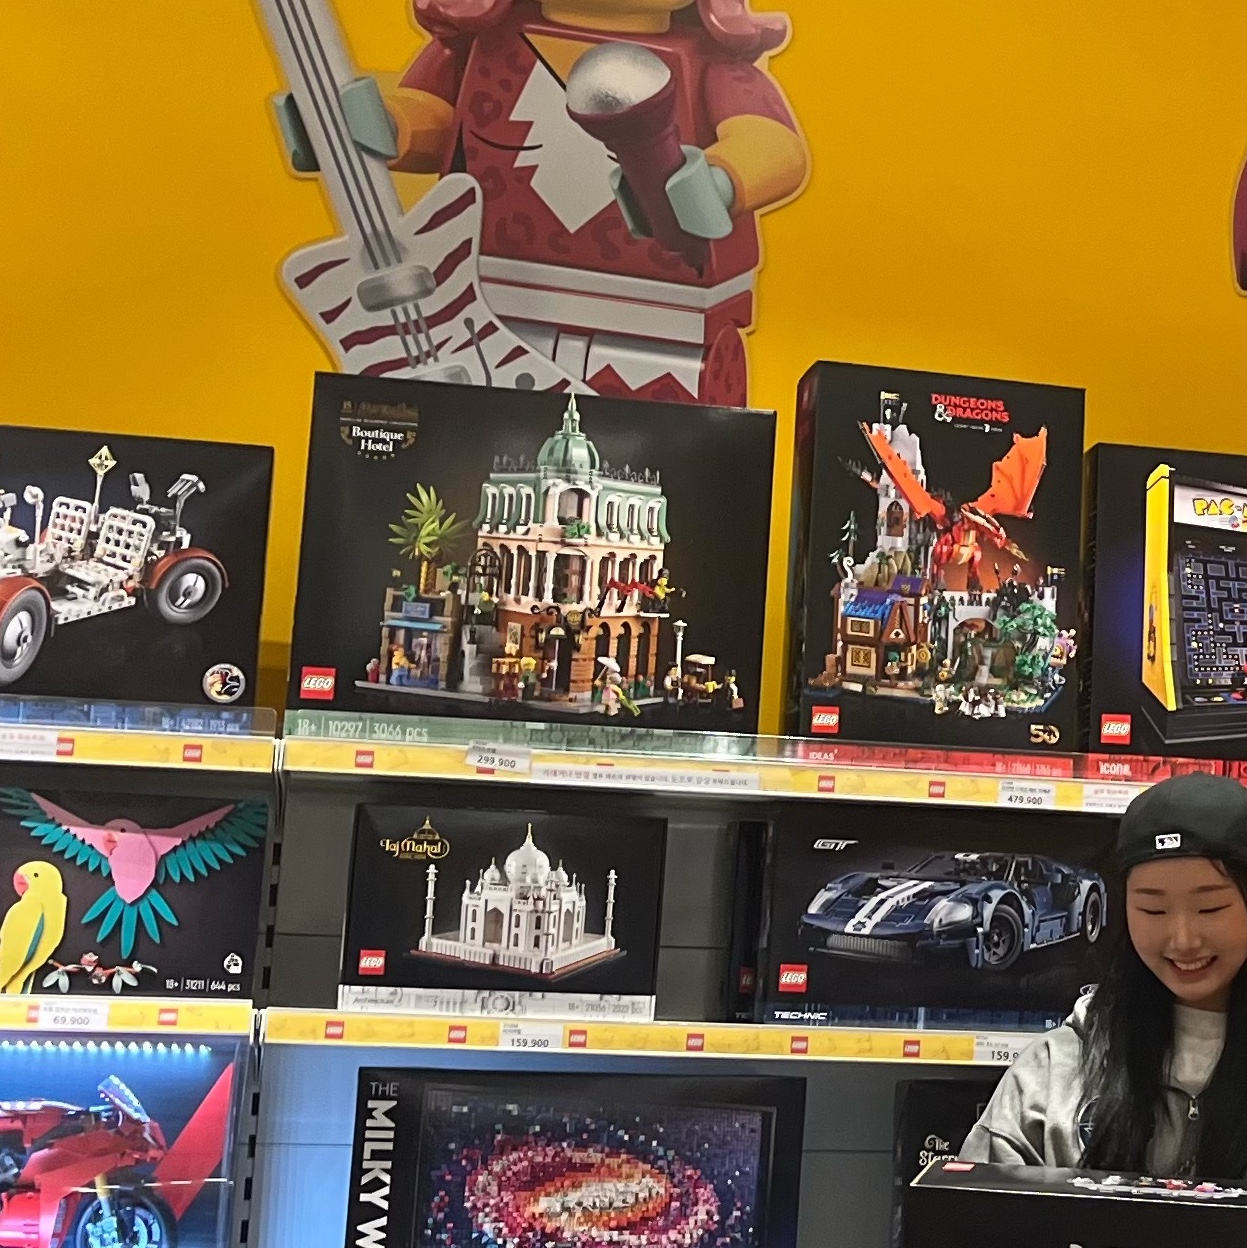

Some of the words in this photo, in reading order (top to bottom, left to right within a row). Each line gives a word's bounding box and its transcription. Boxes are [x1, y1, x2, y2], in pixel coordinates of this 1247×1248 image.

[931, 393, 1005, 411] DUNGEONS
[947, 406, 1011, 424] DRAGONS
[352, 426, 405, 442] Boutique
[361, 439, 394, 453] Hotel
[303, 676, 334, 691] LEGO
[812, 714, 839, 726] LEGO
[297, 719, 318, 738] 18+
[328, 721, 363, 740] 10297
[372, 723, 403, 742] 3066
[405, 726, 429, 744] pcs
[1102, 722, 1130, 736] LEGO
[380, 837, 404, 858] Taj
[401, 837, 451, 860] Mahal
[361, 958, 384, 969] LEGO
[780, 971, 808, 985] LEGO
[165, 979, 179, 990] 18+
[210, 981, 228, 992] 644
[229, 983, 241, 993] pcs
[773, 1009, 829, 1021] TECHNIC
[370, 1082, 399, 1098] THE
[358, 1099, 398, 1211] MILKY
